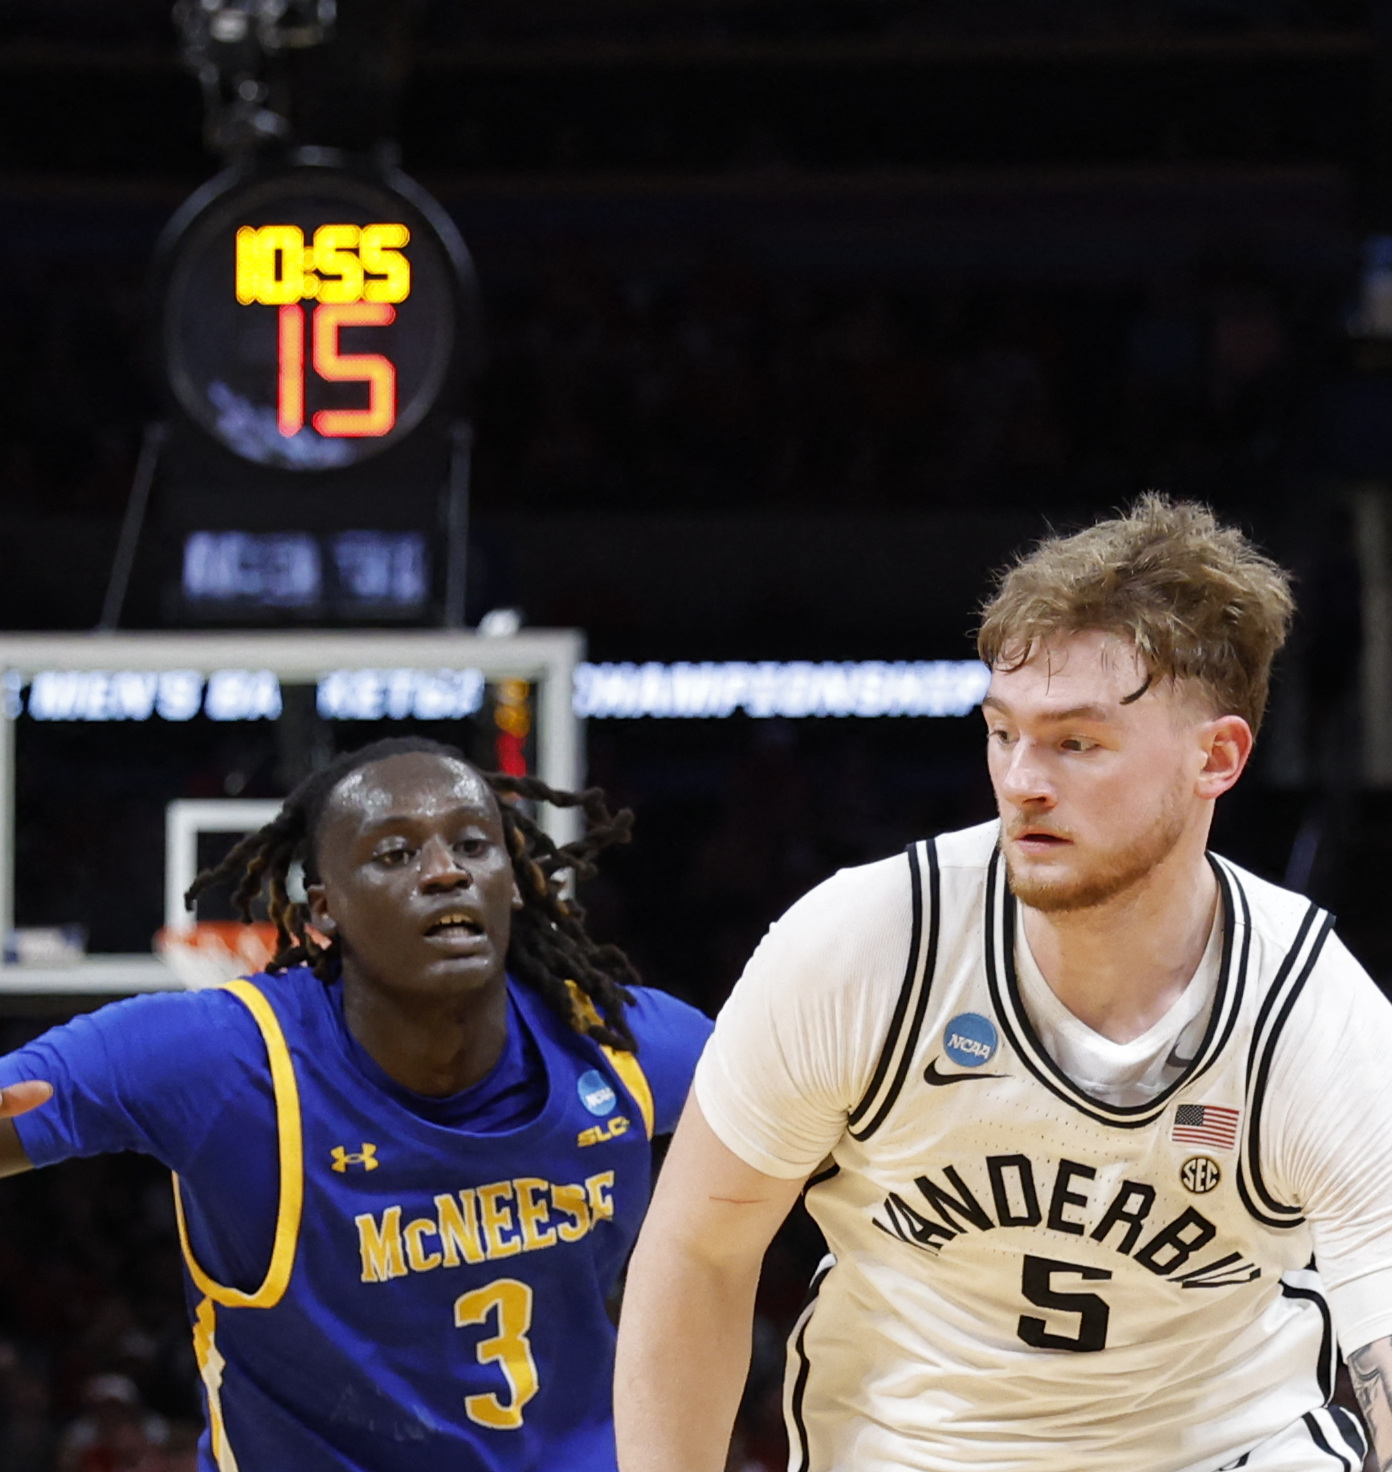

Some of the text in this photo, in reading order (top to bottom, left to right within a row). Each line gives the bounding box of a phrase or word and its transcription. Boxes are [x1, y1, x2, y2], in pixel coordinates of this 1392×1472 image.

[236, 224, 410, 304] 10:55
[277, 301, 396, 437] 15
[947, 1033, 991, 1060] NCAA
[576, 1115, 630, 1148] SLC
[1182, 1157, 1219, 1192] SEC
[1016, 1254, 1113, 1353] 5
[454, 1278, 540, 1430] 3
